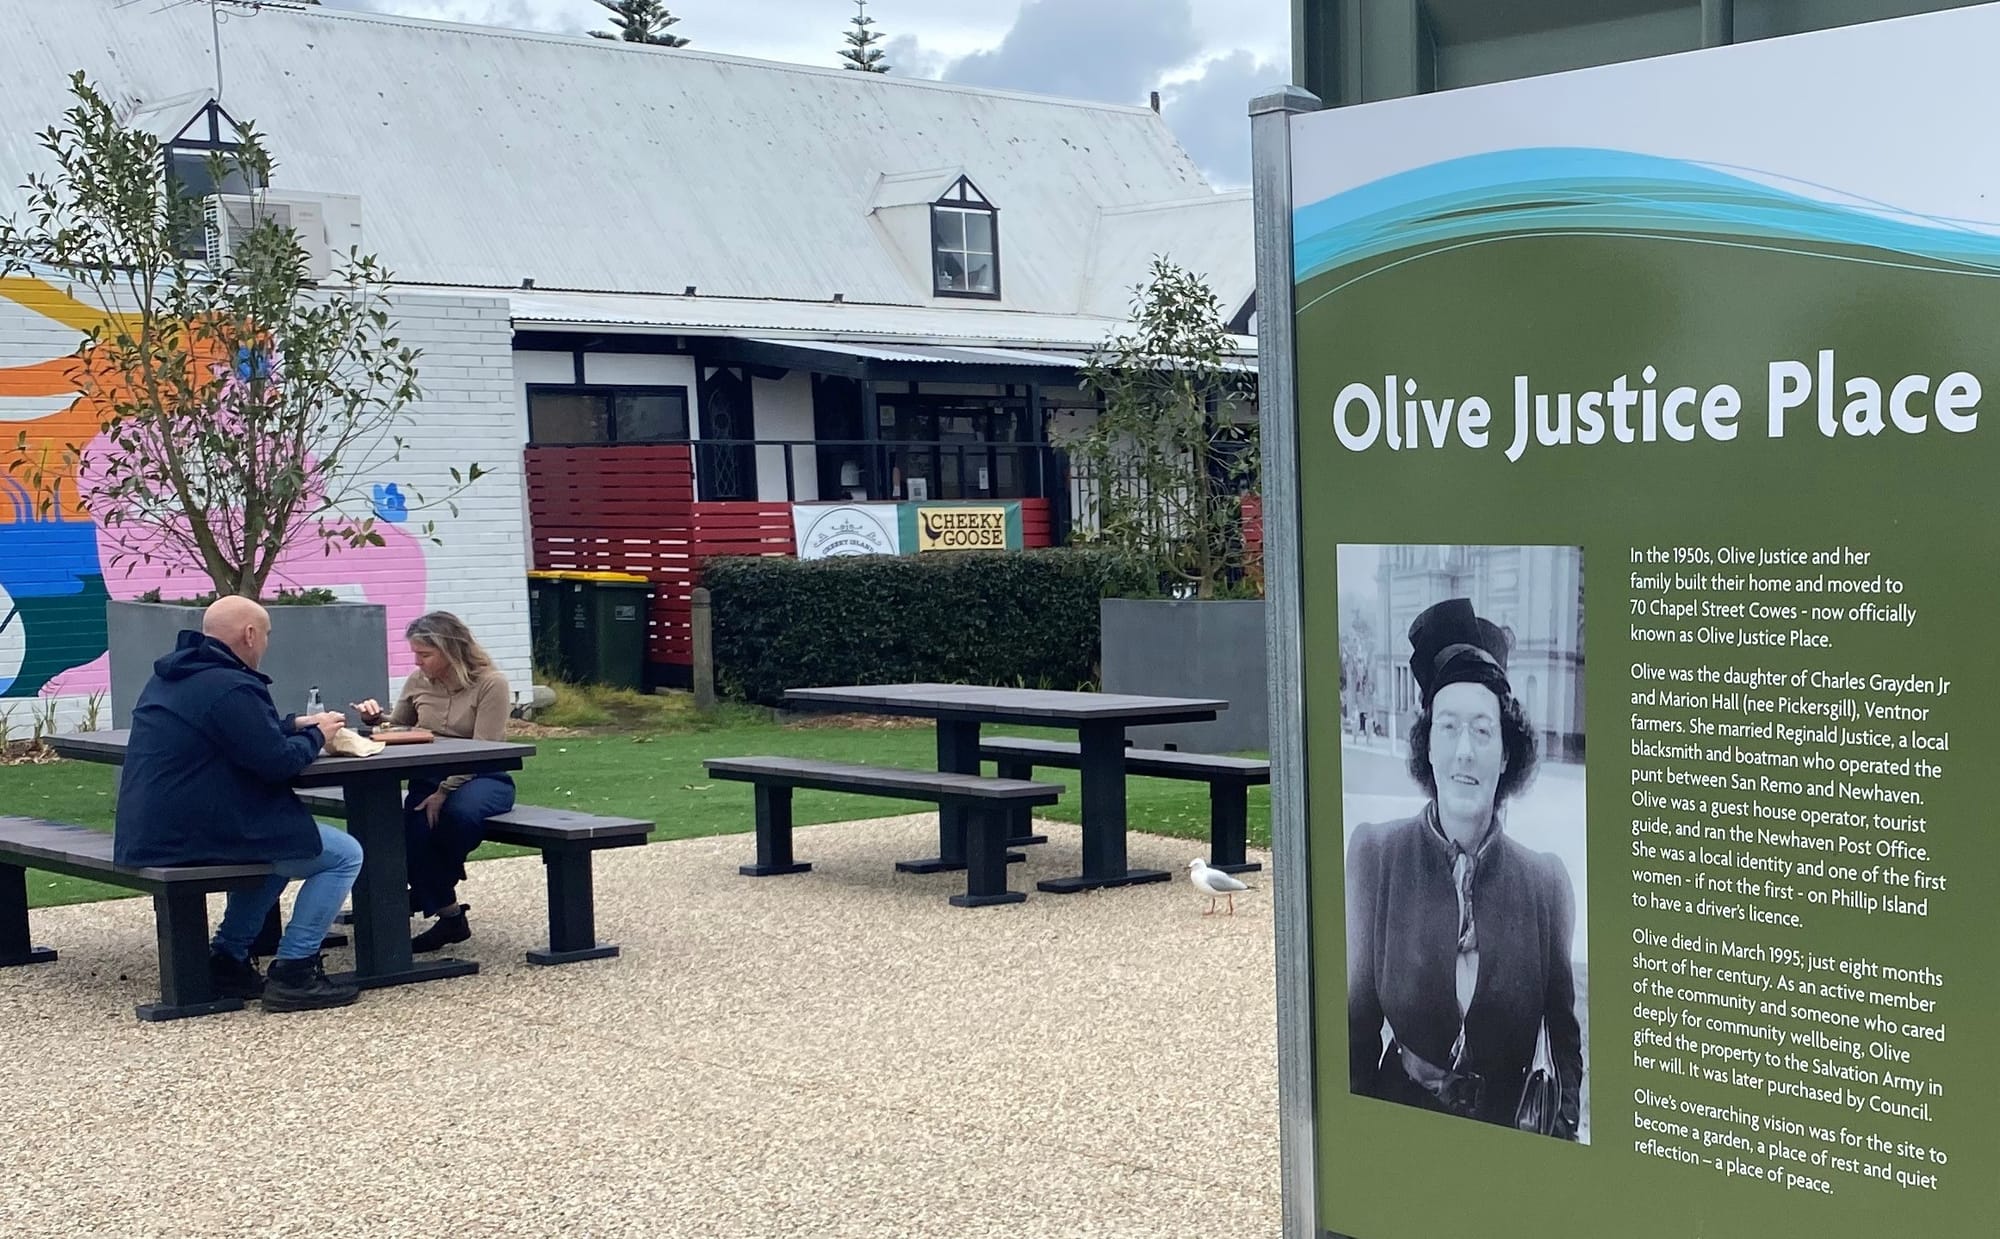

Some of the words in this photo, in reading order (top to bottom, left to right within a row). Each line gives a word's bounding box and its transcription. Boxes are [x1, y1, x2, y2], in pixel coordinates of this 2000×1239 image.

[1333, 375, 1491, 452] Olive
[1504, 365, 1742, 463] Justice
[1768, 350, 1982, 438] Place
[930, 513, 1004, 530] CHEEKY
[943, 529, 1003, 546] GOOSE
[1630, 546, 1643, 564] In
[1645, 545, 1670, 564] the
[1672, 547, 1714, 566] 1950s,
[1717, 545, 1756, 565] Olive
[1757, 547, 1809, 567] Justice
[1811, 546, 1840, 565] and
[1844, 546, 1871, 565] her
[1630, 571, 1672, 595] family
[1675, 572, 1708, 591] built
[1710, 572, 1746, 591] their
[1748, 572, 1792, 592] home
[1795, 573, 1824, 593] and
[1827, 574, 1881, 594] moved
[1884, 577, 1904, 594] to
[1629, 598, 1647, 616] 70
[1649, 598, 1698, 621] Chapel
[1701, 600, 1746, 618] Street
[1748, 601, 1798, 620] Cowes
[1811, 607, 1845, 621] now
[1848, 602, 1917, 628] officially
[1630, 623, 1676, 643] known
[1679, 630, 1694, 643] as
[1697, 625, 1735, 645] Olive
[1736, 628, 1787, 648] Justice
[1790, 628, 1833, 648] Place.
[1630, 661, 1666, 681] Olive
[1668, 668, 1694, 682] was
[1696, 664, 1721, 683] the
[1723, 665, 1788, 690] daughter
[1790, 669, 1809, 688] of
[1810, 670, 1866, 690] Charles
[1869, 673, 1935, 697] Grayden
[1935, 676, 1951, 697] Jr
[1630, 688, 1656, 706] and
[1659, 690, 1708, 709] Marion
[1712, 692, 1740, 711] Hall
[1742, 693, 1775, 716] (nee
[1778, 696, 1861, 723] Pickersgill),
[1864, 701, 1930, 722] Ventnor
[1630, 712, 1686, 734] farmers.
[1689, 716, 1715, 736] She
[1718, 721, 1773, 739] married
[1776, 723, 1838, 747] Reginald
[1839, 727, 1895, 750] Justice,
[1898, 735, 1908, 748] a
[1911, 729, 1949, 751] local
[1631, 737, 1703, 761] blacksmith
[1705, 744, 1732, 763] and
[1735, 745, 1799, 768] boatman
[1802, 751, 1836, 771] who
[1838, 757, 1910, 777] operated
[1913, 758, 1942, 779] the
[1631, 789, 1667, 809] Olive
[1670, 797, 1696, 812] was
[1699, 800, 1708, 813] a
[1710, 801, 1750, 819] guest
[1753, 799, 1797, 821] house
[1800, 809, 1870, 831] operator,
[1872, 813, 1927, 834] tourist
[1631, 816, 1672, 837] guide,
[1675, 820, 1701, 838] and
[1704, 826, 1726, 841] ran
[1728, 823, 1754, 843] the
[1757, 827, 1835, 852] Newhaven
[1838, 835, 1873, 856] Post
[1875, 839, 1931, 861] Office.
[1631, 839, 1657, 859] She
[1659, 847, 1685, 862] was
[1688, 850, 1697, 863] a
[1699, 846, 1733, 867] local
[1736, 851, 1793, 878] identity
[1796, 859, 1824, 877] and
[1828, 865, 1858, 881] one
[1861, 865, 1881, 883] of
[1882, 866, 1910, 887] the
[1913, 869, 1947, 891] first
[1631, 892, 1648, 908] to
[1650, 891, 1682, 912] have
[1684, 901, 1693, 914] a
[1696, 897, 1746, 920] driver's
[1749, 903, 1803, 928] licence.
[1632, 927, 1668, 948] Olive
[1671, 932, 1702, 953] died
[1705, 937, 1718, 955] in
[1721, 940, 1766, 962] March
[1768, 946, 1805, 970] 1995;
[1807, 951, 1836, 973] just
[1839, 957, 1879, 980] eight
[1882, 966, 1943, 987] months
[1632, 951, 1669, 973] short
[1671, 958, 1688, 975] of
[1690, 959, 1714, 979] her
[1716, 968, 1773, 992] century.
[1776, 974, 1795, 992] As
[1798, 980, 1817, 996] an
[1819, 983, 1866, 1003] active
[1869, 991, 1937, 1013] member
[1632, 977, 1649, 994] of
[1650, 979, 1674, 999] the
[1677, 988, 1757, 1016] community
[1759, 999, 1787, 1017] and
[1790, 1006, 1860, 1029] someone
[1863, 1013, 1898, 1034] who
[1901, 1023, 1945, 1042] cared
[1633, 1001, 1679, 1028] deeply
[1681, 1008, 1703, 1028] for
[1705, 1018, 1787, 1047] community
[1790, 1029, 1865, 1060] wellbeing,
[1869, 1041, 1911, 1064] Olive
[1633, 1027, 1672, 1048] gifted
[1674, 1033, 1698, 1053] the
[1701, 1042, 1762, 1068] property
[1764, 1051, 1781, 1068] to
[1783, 1052, 1809, 1073] the
[1812, 1058, 1879, 1085] Salvation
[1882, 1070, 1925, 1097] Army
[1928, 1077, 1943, 1097] in
[1633, 1049, 1657, 1070] her
[1658, 1056, 1686, 1076] will.
[1689, 1061, 1700, 1078] It
[1702, 1067, 1729, 1084] was
[1732, 1067, 1765, 1090] later
[1767, 1079, 1843, 1105] purchased
[1846, 1088, 1866, 1113] by
[1869, 1095, 1933, 1122] Council.
[1634, 1088, 1677, 1111] Olive's
[1679, 1100, 1760, 1132] overarching
[1762, 1114, 1805, 1137] vision
[1808, 1125, 1836, 1143] was
[1839, 1127, 1864, 1148] for
[1865, 1133, 1893, 1154] the
[1896, 1140, 1926, 1161] site
[1928, 1147, 1948, 1165] to
[1634, 1110, 1689, 1138] become
[1691, 1127, 1700, 1140] a
[1703, 1130, 1754, 1154] garden,
[1756, 1141, 1766, 1154] a
[1768, 1140, 1807, 1163] place
[1810, 1149, 1829, 1167] of
[1831, 1156, 1860, 1174] rest
[1863, 1162, 1892, 1181] and
[1895, 1169, 1938, 1191] quiet
